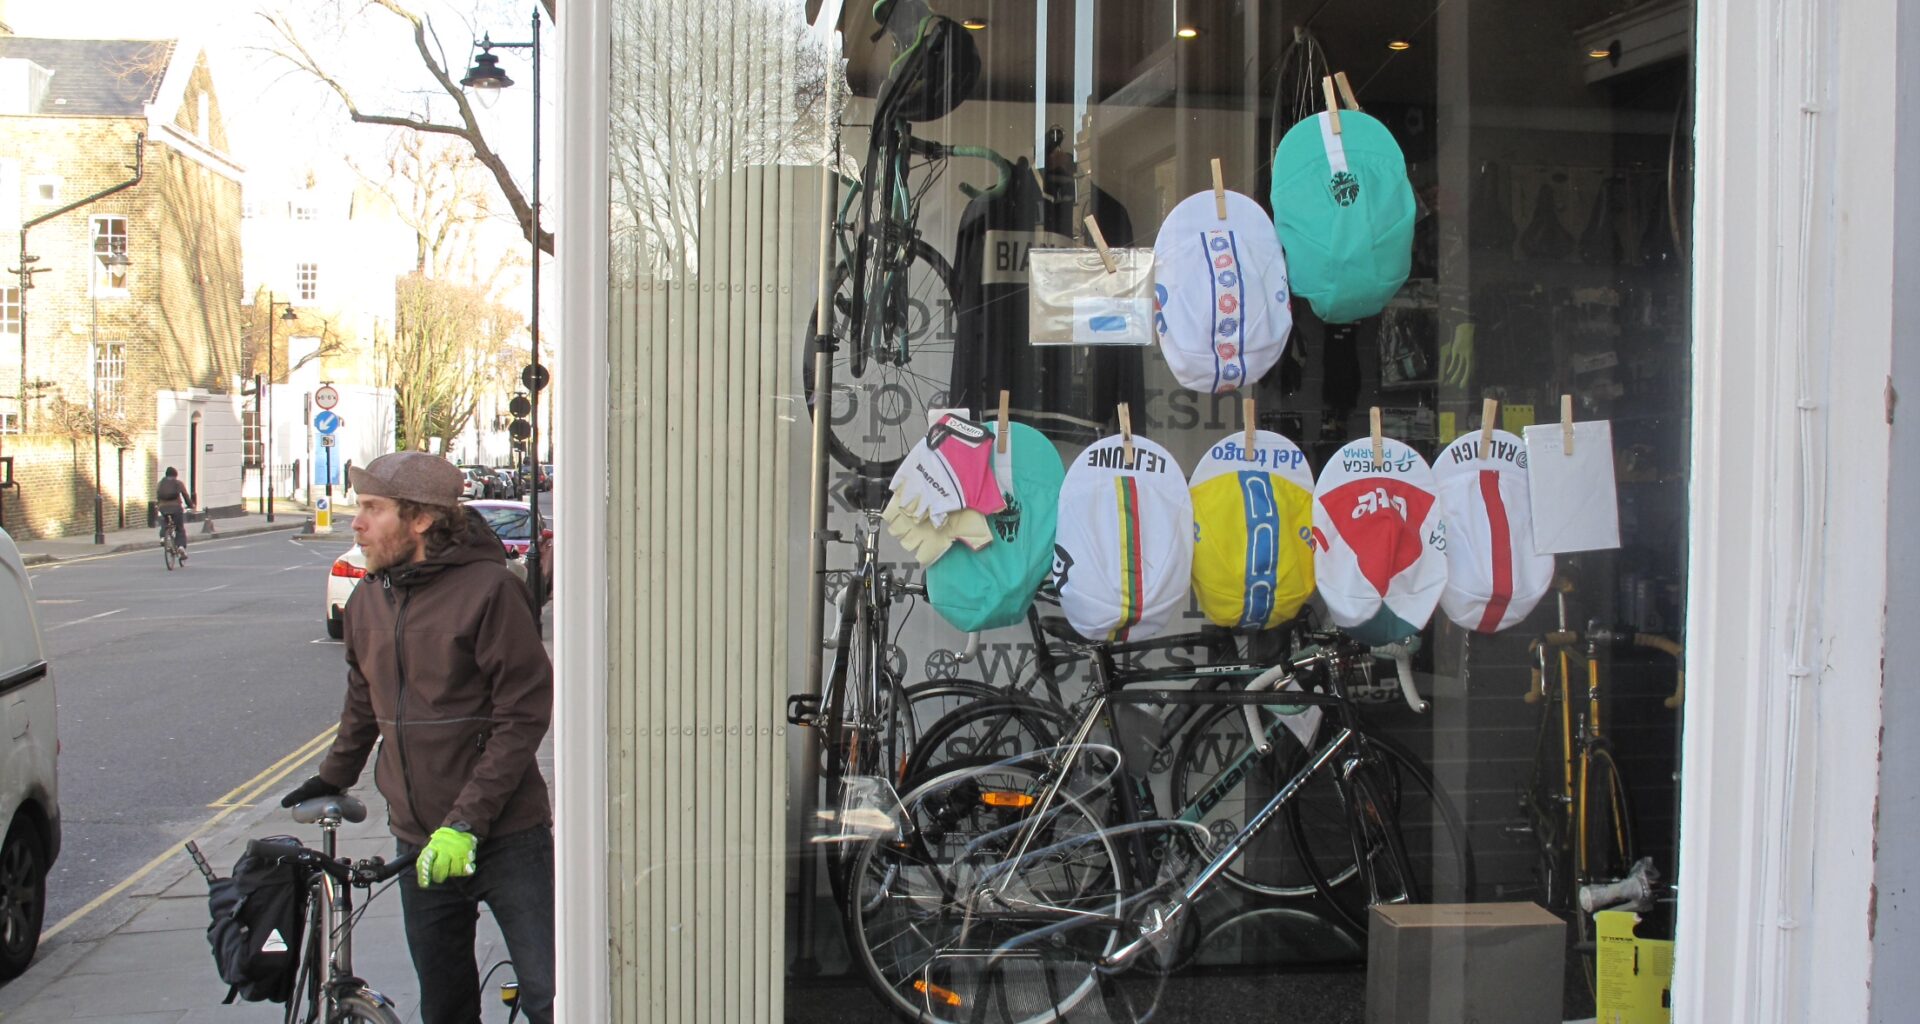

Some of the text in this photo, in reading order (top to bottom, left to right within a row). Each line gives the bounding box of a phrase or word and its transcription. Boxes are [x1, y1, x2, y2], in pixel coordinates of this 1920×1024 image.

[1273, 446, 1303, 470] del
[1450, 440, 1517, 465] RALIGH
[916, 463, 949, 497] Bianchi
